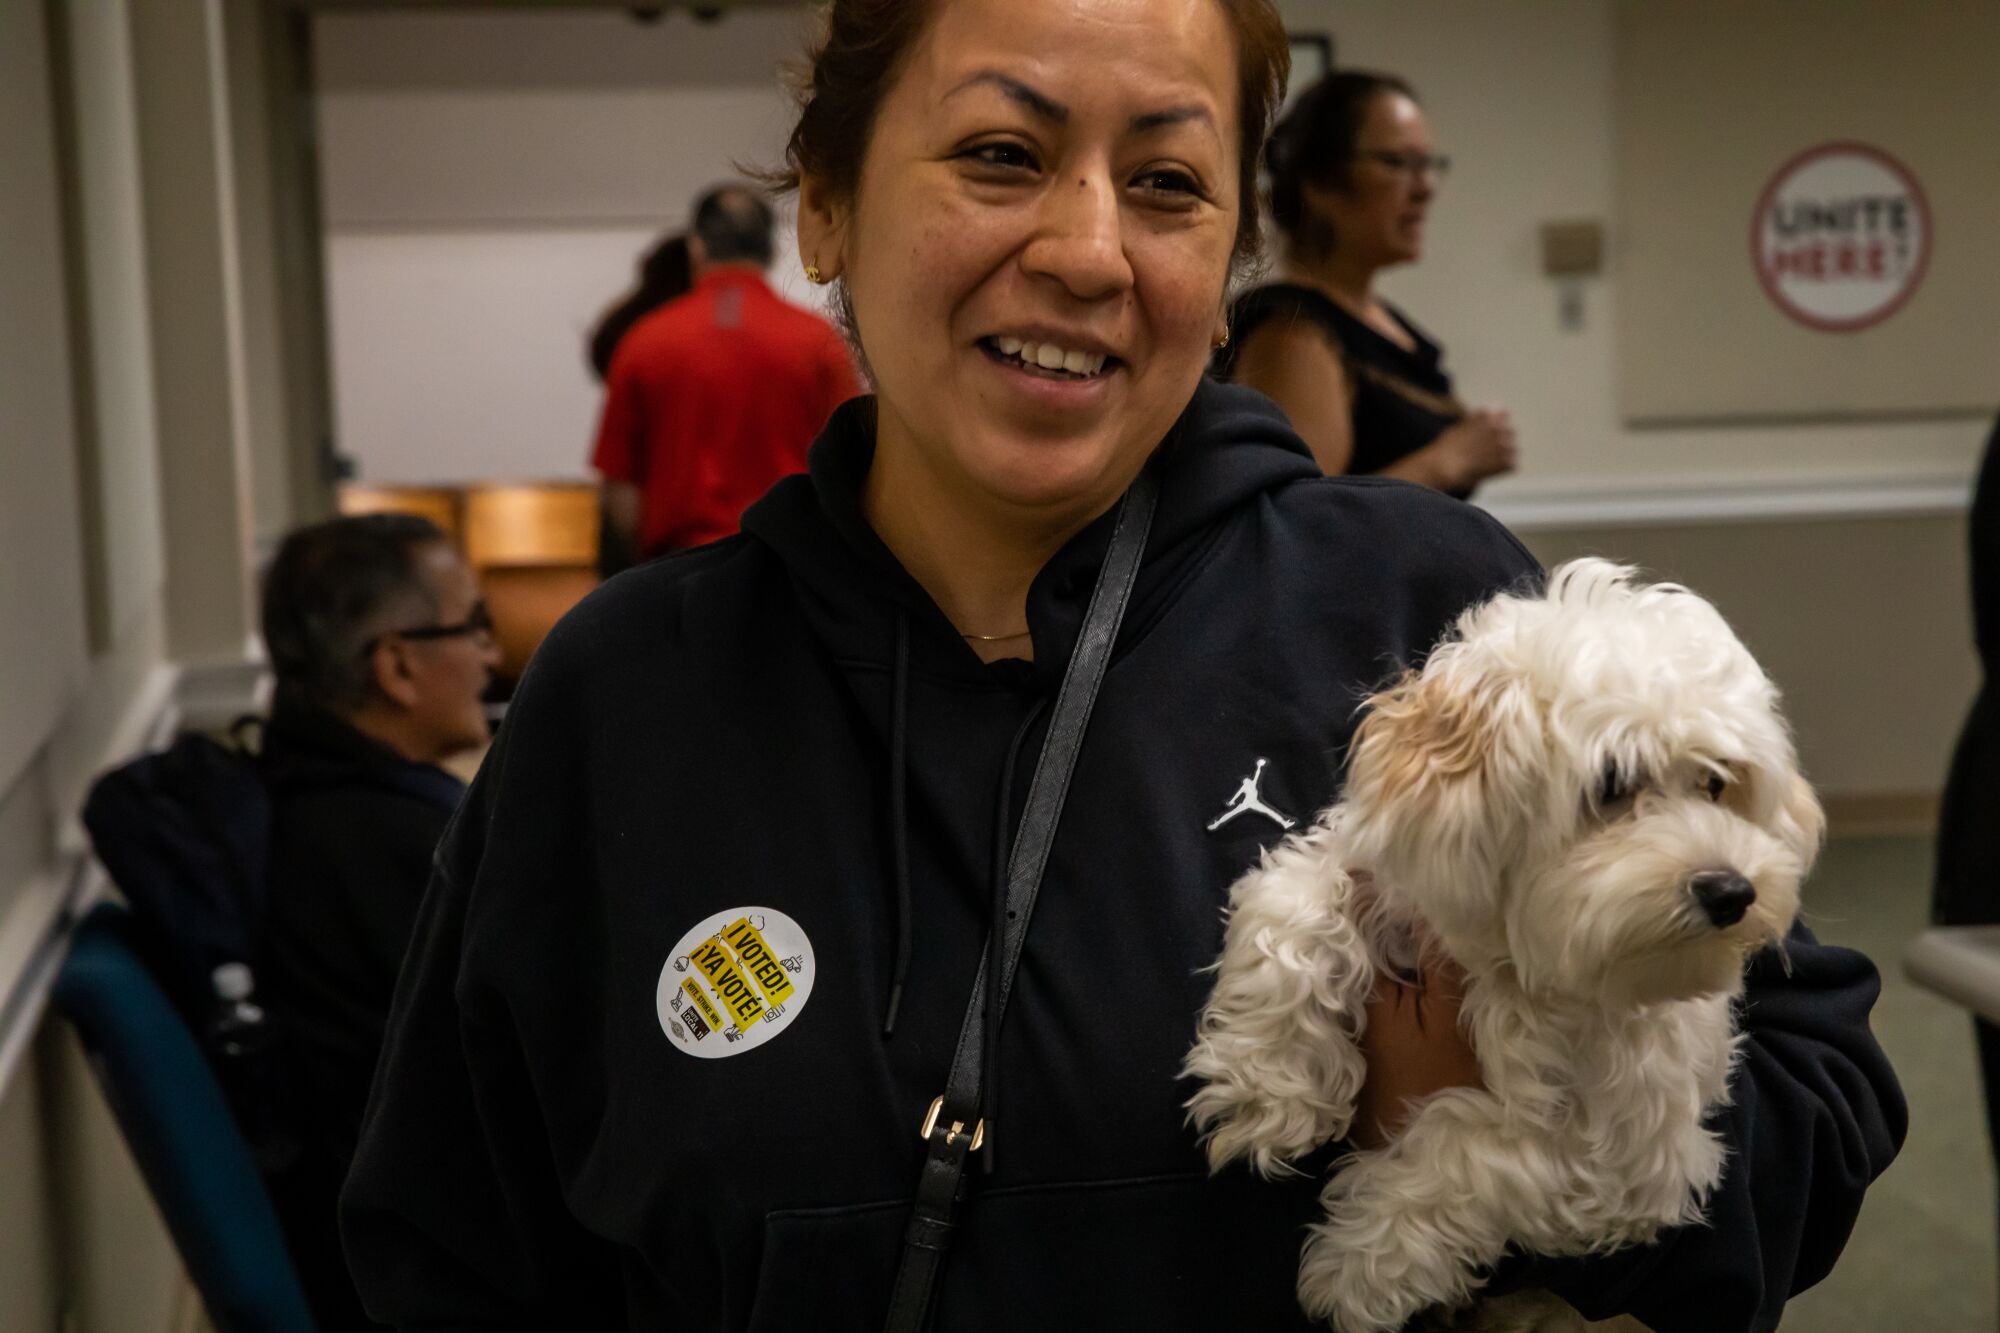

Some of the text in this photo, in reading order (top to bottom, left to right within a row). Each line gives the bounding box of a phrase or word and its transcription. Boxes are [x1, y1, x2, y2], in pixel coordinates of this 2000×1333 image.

[1774, 197, 1907, 236] UNITE
[691, 944, 763, 1021] ¡YA VOTÉ!
[727, 924, 789, 996] I VOTED!
[681, 1011, 699, 1032] LOCAL
[696, 1030, 704, 1039] 11
